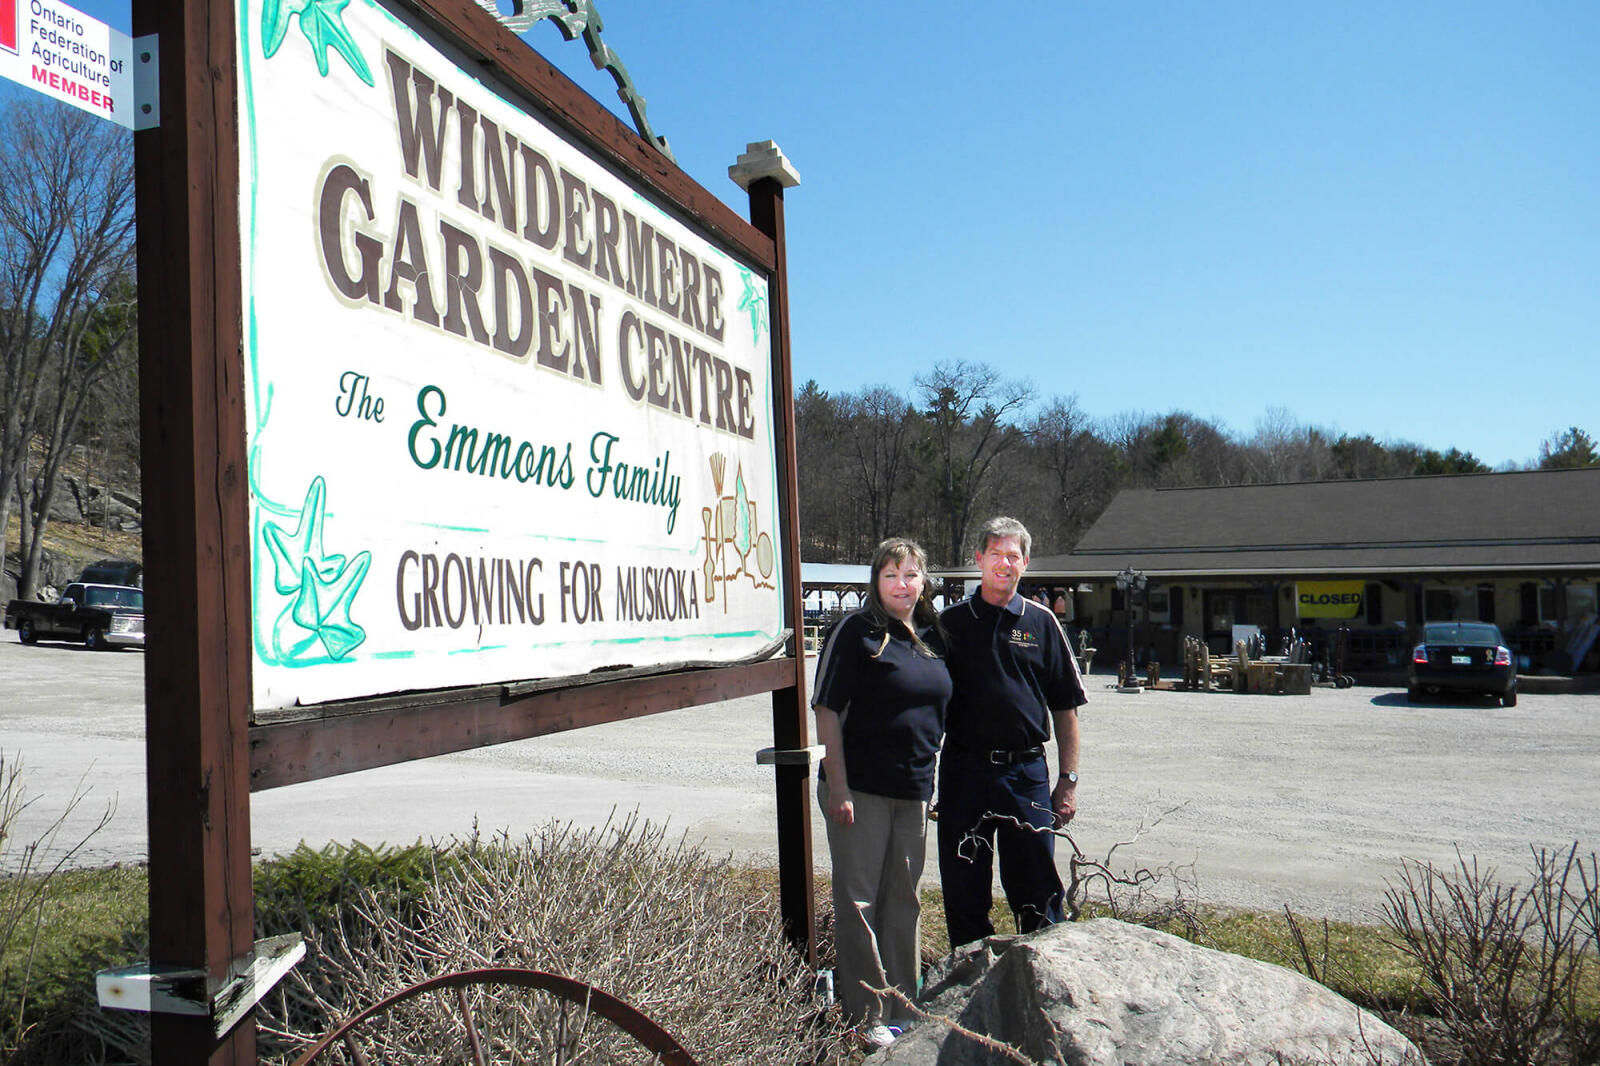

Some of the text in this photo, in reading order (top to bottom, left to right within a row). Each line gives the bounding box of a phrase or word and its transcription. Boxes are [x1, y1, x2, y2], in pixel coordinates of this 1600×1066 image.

[30, 0, 84, 36] Ontario
[30, 19, 123, 74] Federation of
[32, 41, 110, 87] Agriculture
[32, 64, 115, 112] MEMBER
[384, 46, 727, 343] WINDERMERE
[318, 162, 756, 440] GARDEN CENTRE
[335, 371, 681, 535] The Emmons Family
[396, 549, 700, 632] GROWING FOR MUSKOKA
[1299, 593, 1361, 605] CLOSED
